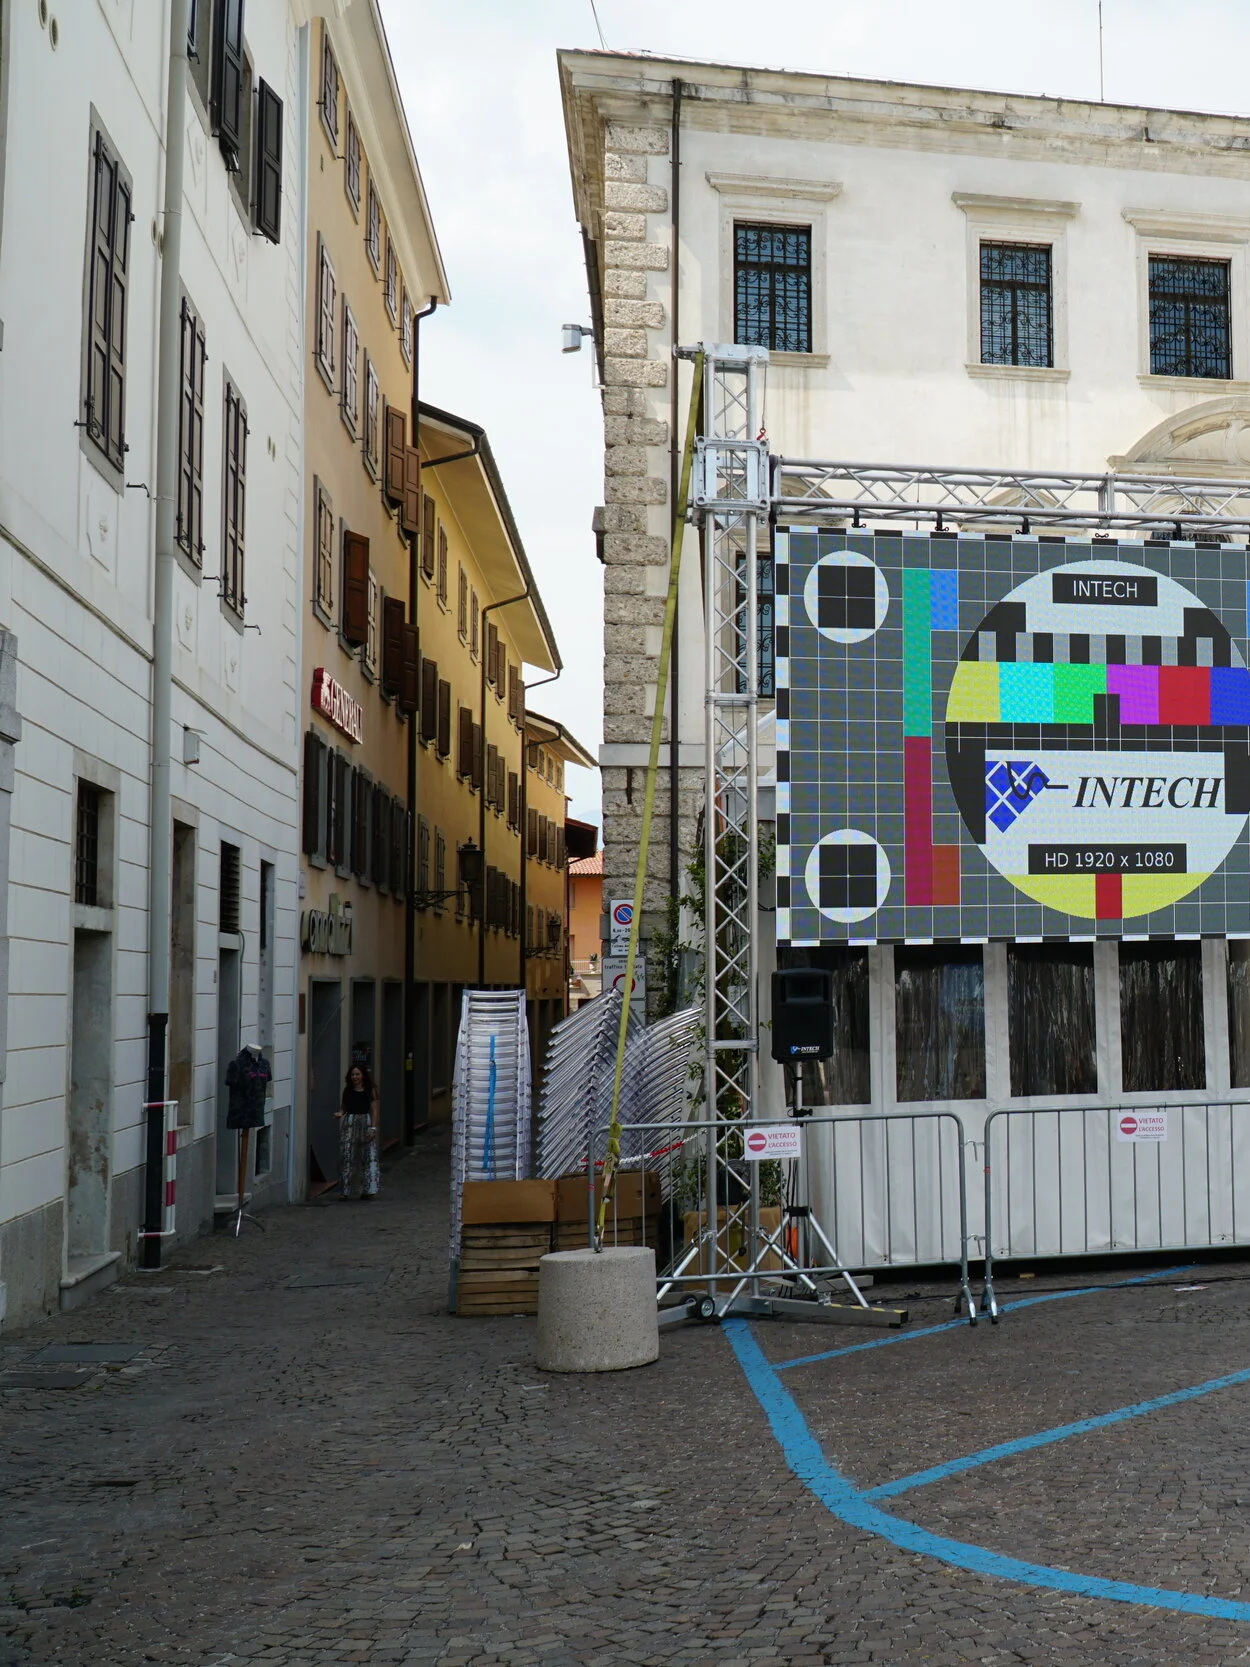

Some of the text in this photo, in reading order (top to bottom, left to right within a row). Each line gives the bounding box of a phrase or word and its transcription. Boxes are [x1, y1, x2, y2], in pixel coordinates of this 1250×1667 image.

[1073, 580, 1138, 598] INTECH
[331, 679, 363, 744] GENERALI
[1072, 776, 1224, 808] INTECH
[1045, 851, 1174, 868] HD 1920 x 1080
[768, 1132, 796, 1140] VIETATO
